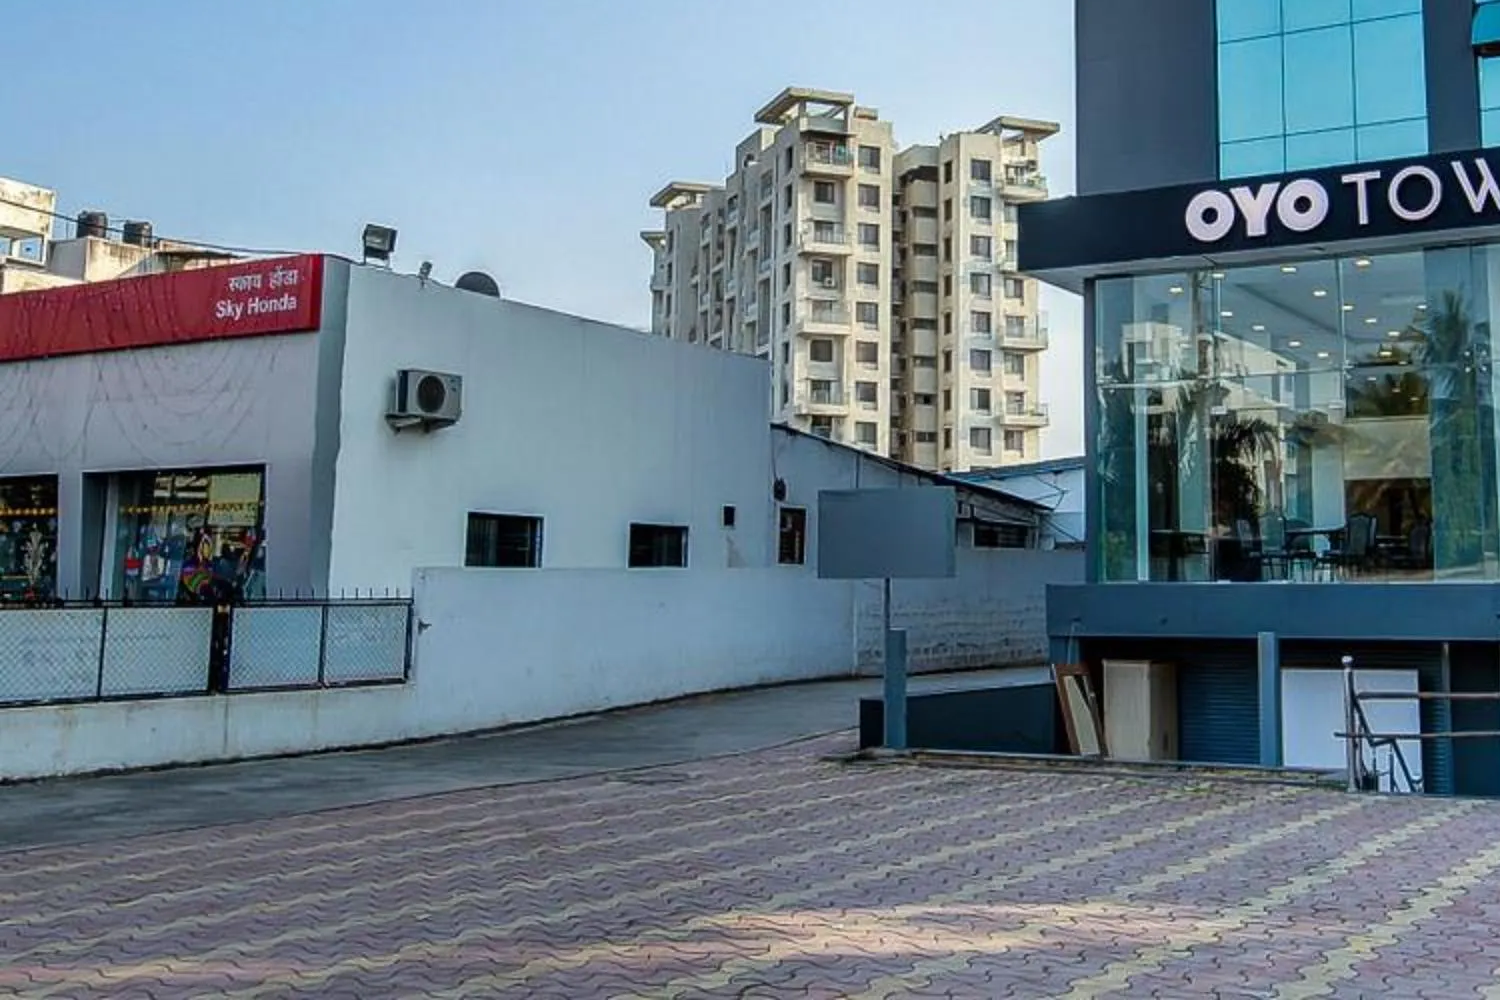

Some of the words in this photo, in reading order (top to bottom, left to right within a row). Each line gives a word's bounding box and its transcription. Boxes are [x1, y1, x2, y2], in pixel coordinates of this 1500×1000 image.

[1184, 178, 1330, 242] OYO
[215, 299, 244, 321] Sky
[247, 293, 297, 315] Honda
